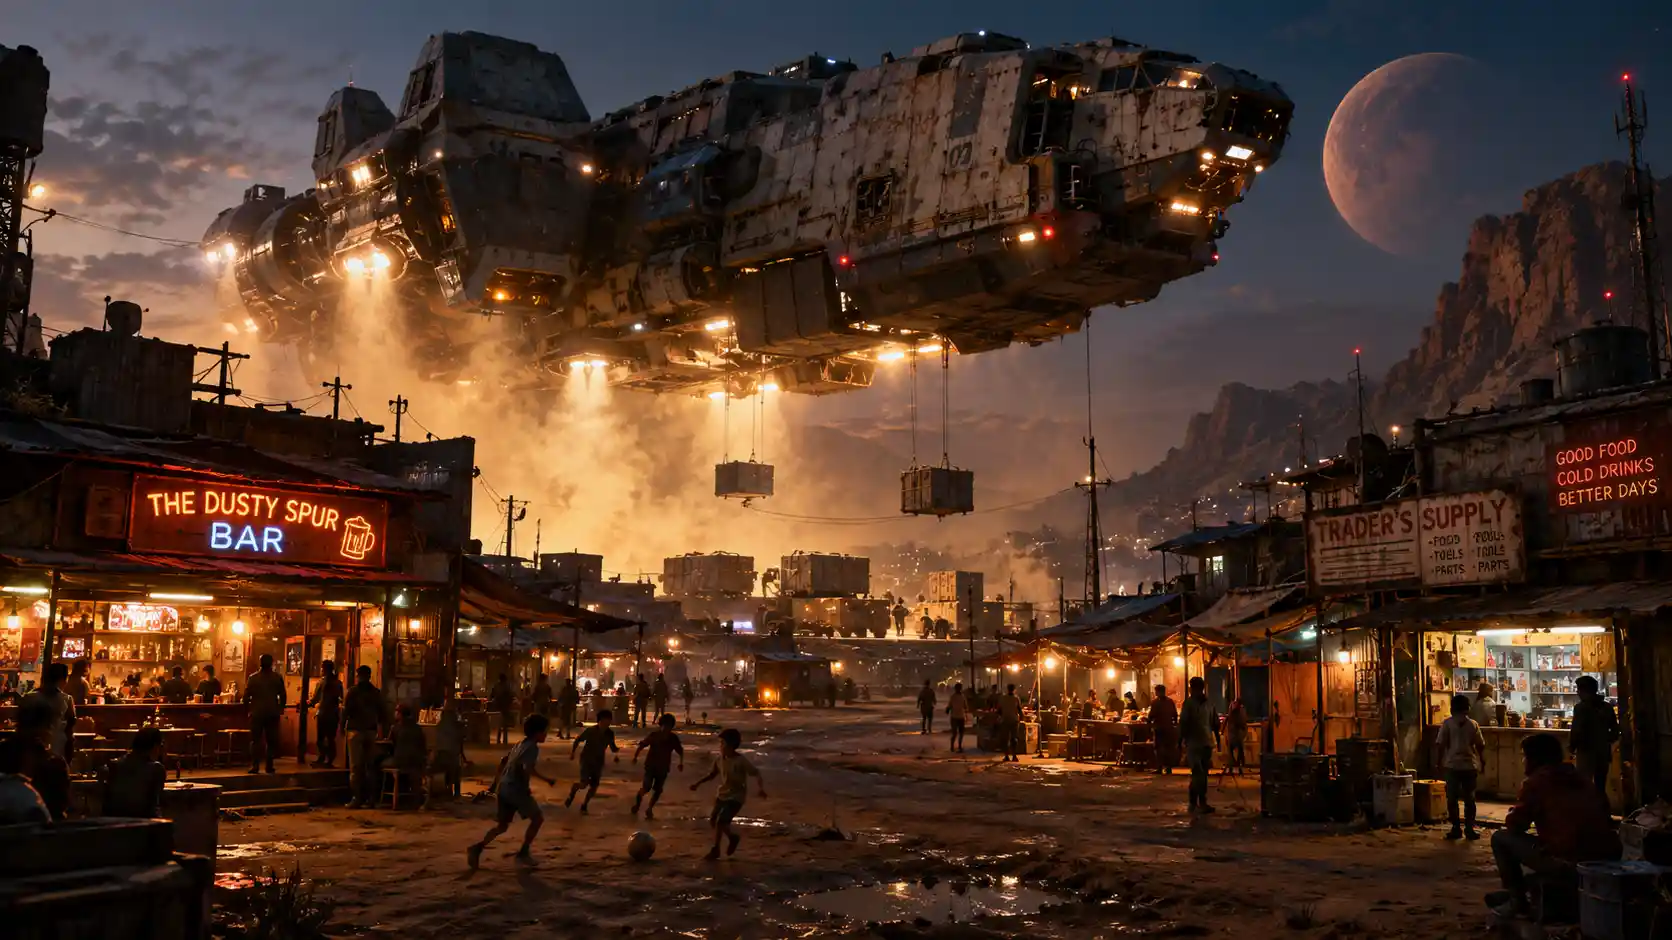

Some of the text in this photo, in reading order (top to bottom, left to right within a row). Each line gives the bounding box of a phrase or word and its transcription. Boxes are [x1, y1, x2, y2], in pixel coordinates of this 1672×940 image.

[1556, 439, 1637, 466] GOOD FOOD
[1557, 457, 1654, 486] COLD DRINKS
[1558, 478, 1658, 507] BETTER DAYS
[147, 490, 340, 532] THE DUSTY SPUR
[1315, 497, 1507, 543] TRADER'S SUPPLY
[209, 521, 284, 553] BAR
[1435, 564, 1466, 575] PARTS
[1478, 559, 1510, 573] PARTS
